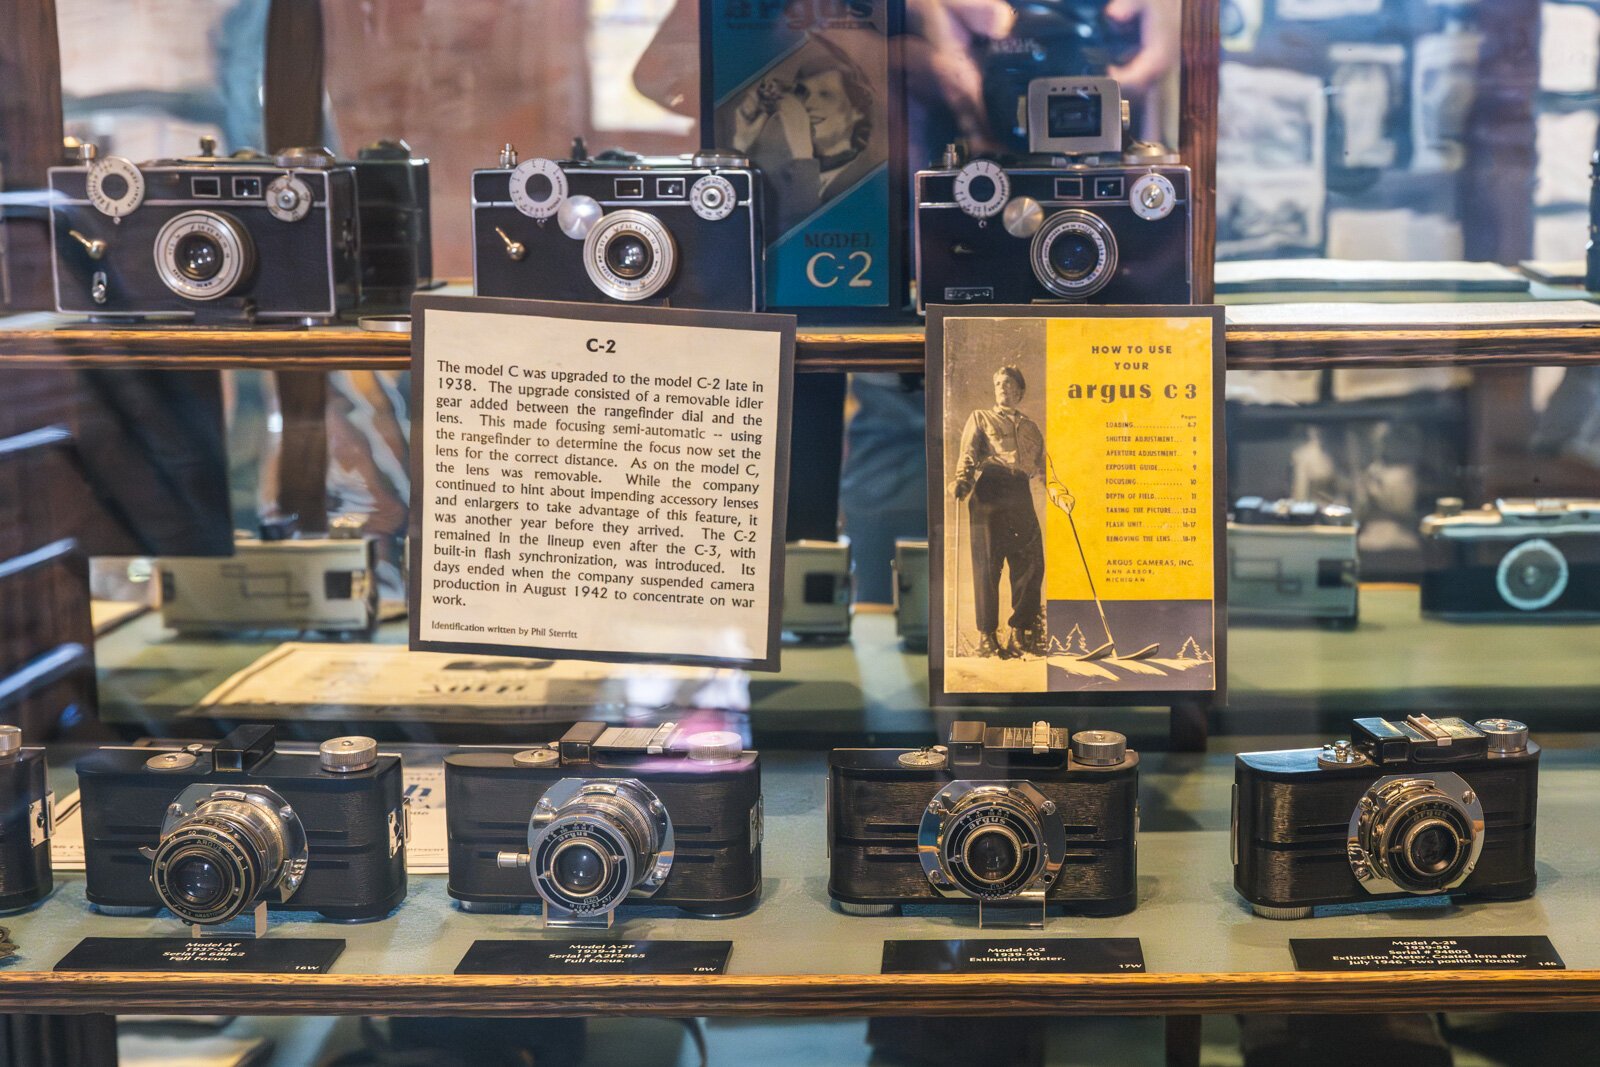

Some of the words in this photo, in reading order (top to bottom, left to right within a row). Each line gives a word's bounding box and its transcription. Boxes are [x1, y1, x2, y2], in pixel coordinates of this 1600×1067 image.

[804, 232, 873, 249] MODEL
[806, 251, 872, 288] C-2
[585, 337, 616, 353] C-2
[1092, 345, 1121, 354] HOW
[1127, 345, 1143, 354] TO
[1149, 345, 1172, 354] USE
[436, 359, 460, 373] The
[464, 364, 503, 376] model
[507, 364, 518, 377] C
[522, 368, 546, 379] was
[550, 370, 608, 383] upgraded
[612, 373, 625, 383] to
[630, 372, 650, 385] the
[654, 375, 692, 388] model
[696, 376, 720, 390] C-2
[725, 378, 748, 391] late
[752, 380, 763, 392] in
[1114, 362, 1149, 370] YOUR
[438, 376, 476, 391] 1938.
[487, 380, 512, 394] The
[517, 384, 569, 398] upgrade
[574, 387, 630, 400] consisted
[634, 390, 650, 402] of
[652, 393, 660, 402] a
[665, 394, 730, 407] removable
[735, 396, 763, 409] idler
[1068, 383, 1152, 403] argus
[1185, 383, 1197, 399] 3
[436, 396, 462, 408] gear
[469, 396, 508, 411] added
[516, 399, 568, 414] between
[576, 402, 596, 415] the
[604, 405, 674, 420] rangefinder
[681, 408, 703, 422] dial
[711, 412, 734, 424] and
[742, 413, 762, 426] the
[435, 410, 462, 424] lens.
[478, 413, 505, 427] This
[513, 417, 547, 430] made
[555, 418, 605, 435] focusing
[612, 422, 705, 439] semi-automatic
[730, 430, 763, 445] using
[435, 427, 455, 440] the
[460, 431, 531, 446] rangefinder
[536, 437, 550, 447] to
[555, 435, 617, 450] determine
[623, 439, 642, 452] the
[649, 440, 680, 454] focus
[686, 446, 712, 456] now
[717, 447, 735, 458] set
[741, 447, 761, 459] the
[435, 443, 458, 457] lens
[465, 446, 483, 459] for
[488, 448, 508, 461] the
[514, 453, 558, 464] correct
[564, 453, 617, 467] distance.
[629, 456, 647, 469] As
[652, 460, 668, 471] on
[675, 459, 694, 472] the
[700, 462, 739, 475] model
[745, 463, 759, 478] C,
[1137, 559, 1176, 567] CAMERAS,
[431, 593, 466, 606] work.
[432, 577, 499, 592] production
[505, 581, 516, 593] in
[522, 582, 566, 597] August
[574, 585, 607, 599] 1942
[614, 589, 627, 600] to
[632, 591, 704, 604] concentrate
[709, 596, 725, 606] on
[731, 597, 755, 607] war
[431, 620, 484, 632] Identification
[486, 625, 515, 634] written
[518, 626, 528, 636] by
[530, 627, 546, 636] Phil
[548, 627, 577, 638] Sterritt
[969, 817, 1006, 830] argus
[196, 839, 222, 853] ARGUS
